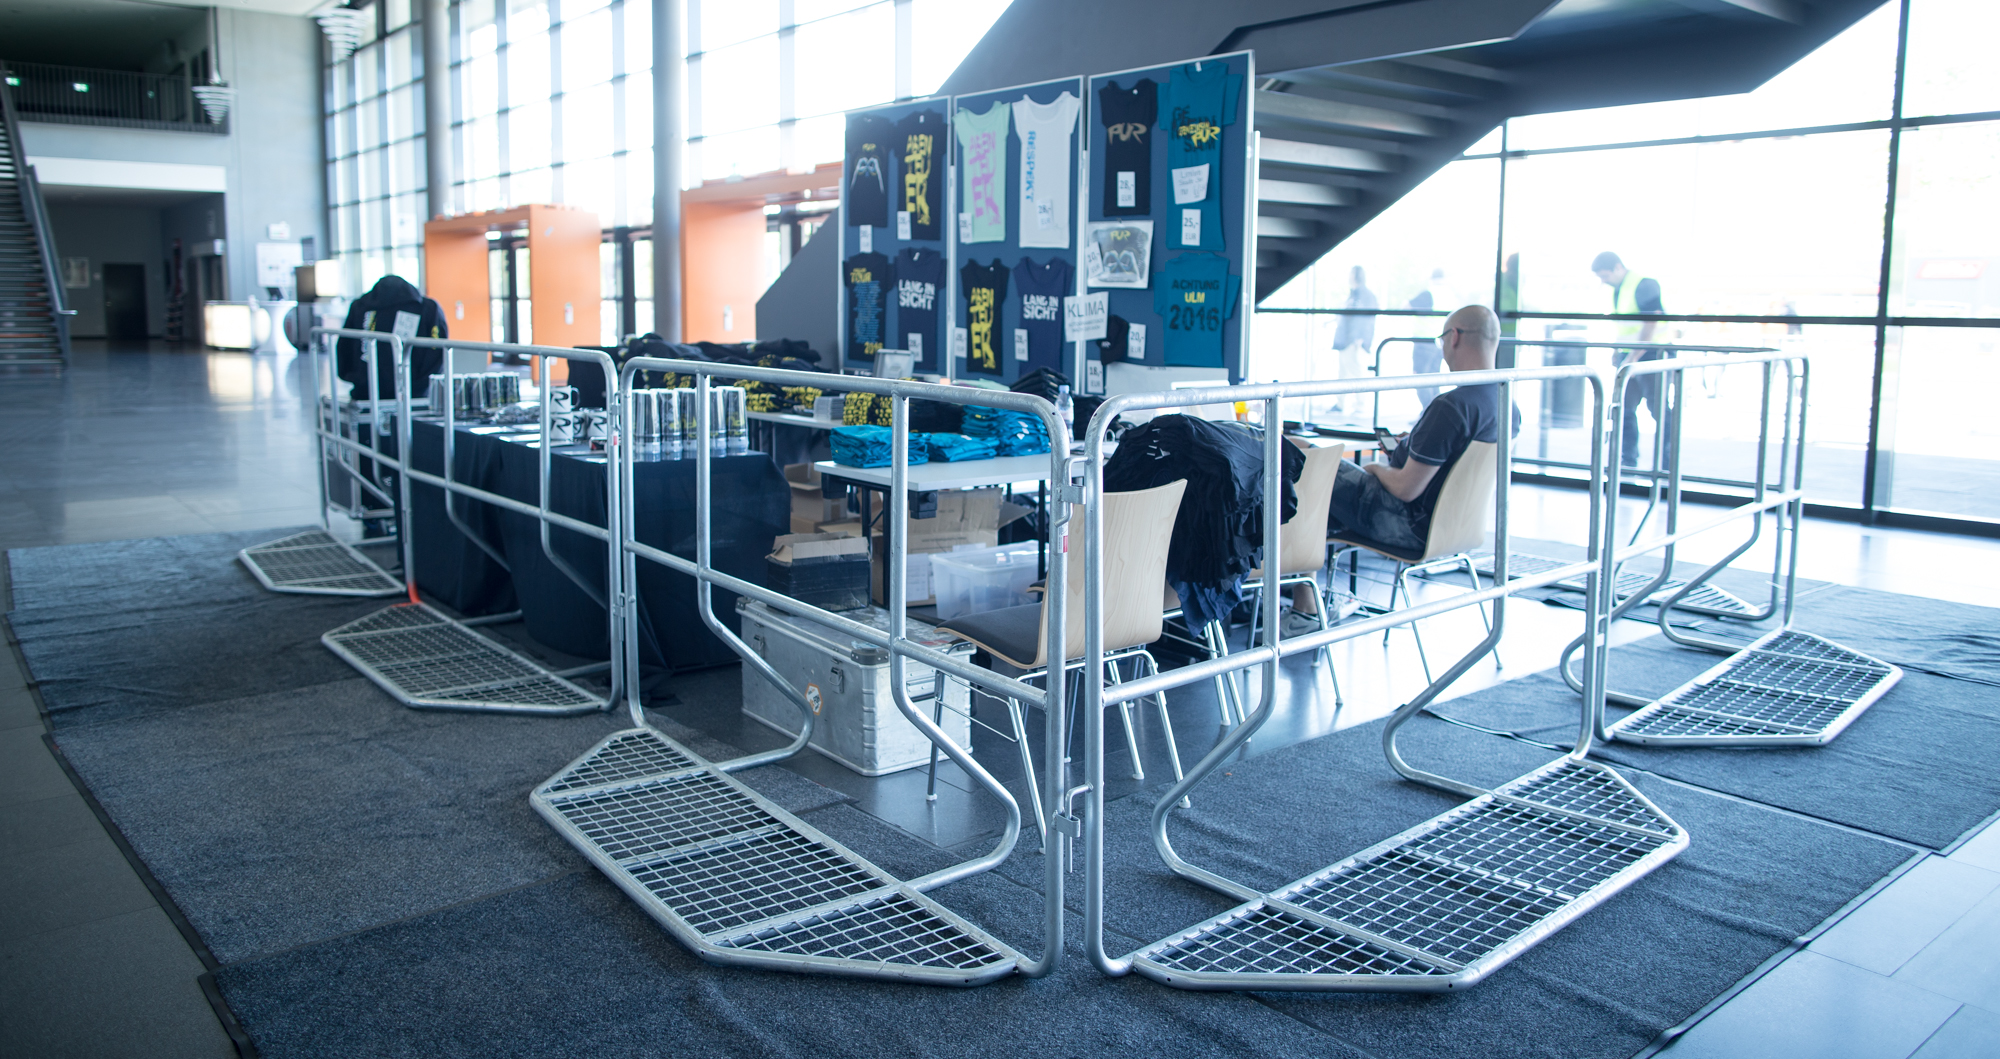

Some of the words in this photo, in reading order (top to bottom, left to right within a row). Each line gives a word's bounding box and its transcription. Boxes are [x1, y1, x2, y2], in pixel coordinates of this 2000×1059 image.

[1107, 122, 1148, 145] PUR
[1190, 126, 1221, 148] PUR
[1025, 130, 1036, 203] RESPEKT
[1119, 179, 1134, 191] 28,-
[1183, 217, 1199, 229] 25,-
[1110, 230, 1131, 242] PUR
[1184, 232, 1197, 240] EUR
[898, 279, 925, 293] LANG
[924, 282, 935, 296] IN
[1171, 279, 1220, 291] ACHTUNG
[899, 292, 934, 311] SICHT
[1023, 294, 1048, 307] LANG
[1048, 296, 1059, 308] IN
[1184, 292, 1206, 304] ULM
[1023, 305, 1058, 321] SICHT
[1067, 300, 1105, 318] KLIMA
[1169, 304, 1220, 331] 2016
[1130, 331, 1144, 343] 20,-
[1089, 366, 1103, 377] 18,-
